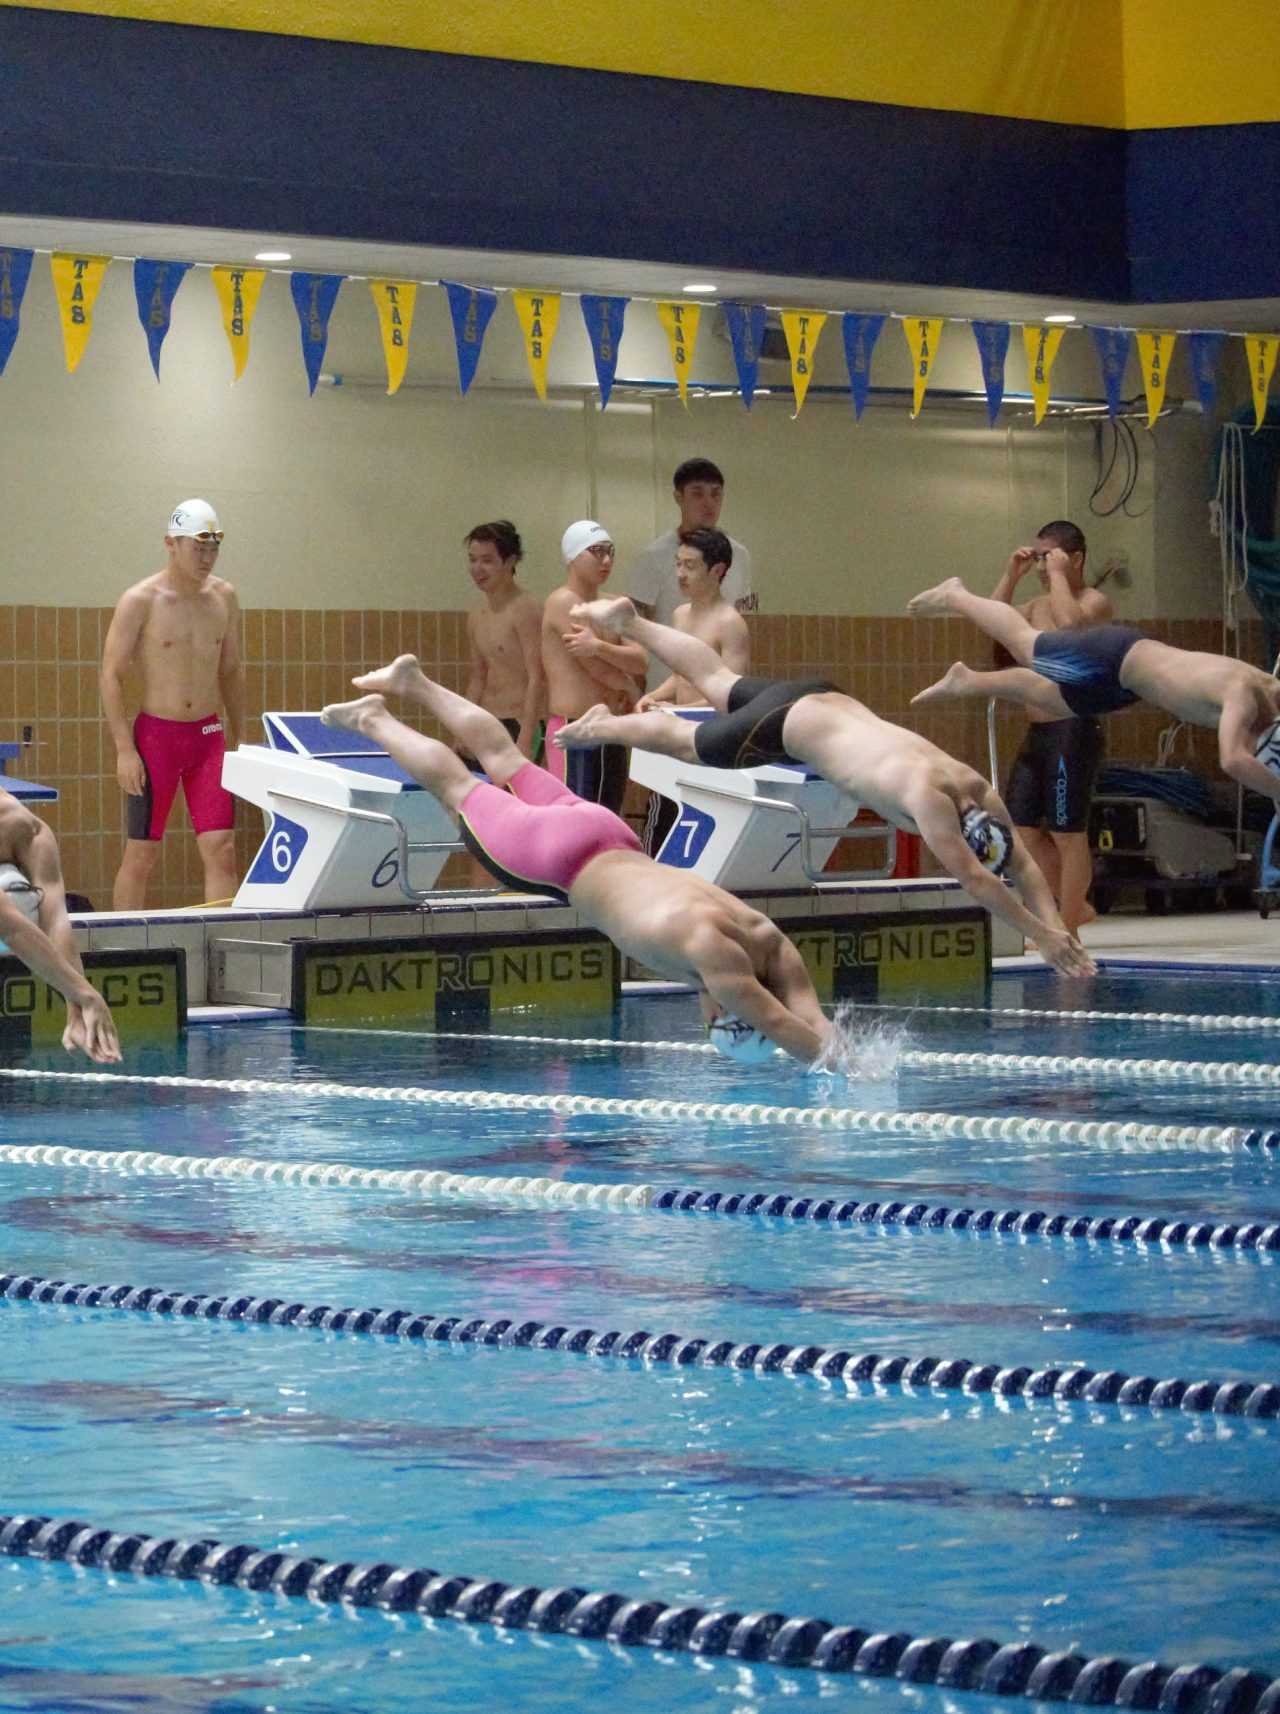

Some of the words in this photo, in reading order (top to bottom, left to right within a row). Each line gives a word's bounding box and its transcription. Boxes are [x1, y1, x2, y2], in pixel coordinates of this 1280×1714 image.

[71, 260, 89, 325] TAS
[230, 271, 244, 337] TAS
[385, 286, 404, 347] TAS
[531, 298, 544, 359] TAS
[672, 305, 686, 365] TAS
[796, 317, 809, 376] TAS
[918, 320, 930, 377] TAS
[1150, 335, 1162, 389] TAS
[271, 831, 292, 873] 6
[679, 820, 699, 858] 7
[371, 847, 399, 889] 6
[315, 949, 603, 996] DAKTRONICS
[794, 927, 976, 968] TRONICS
